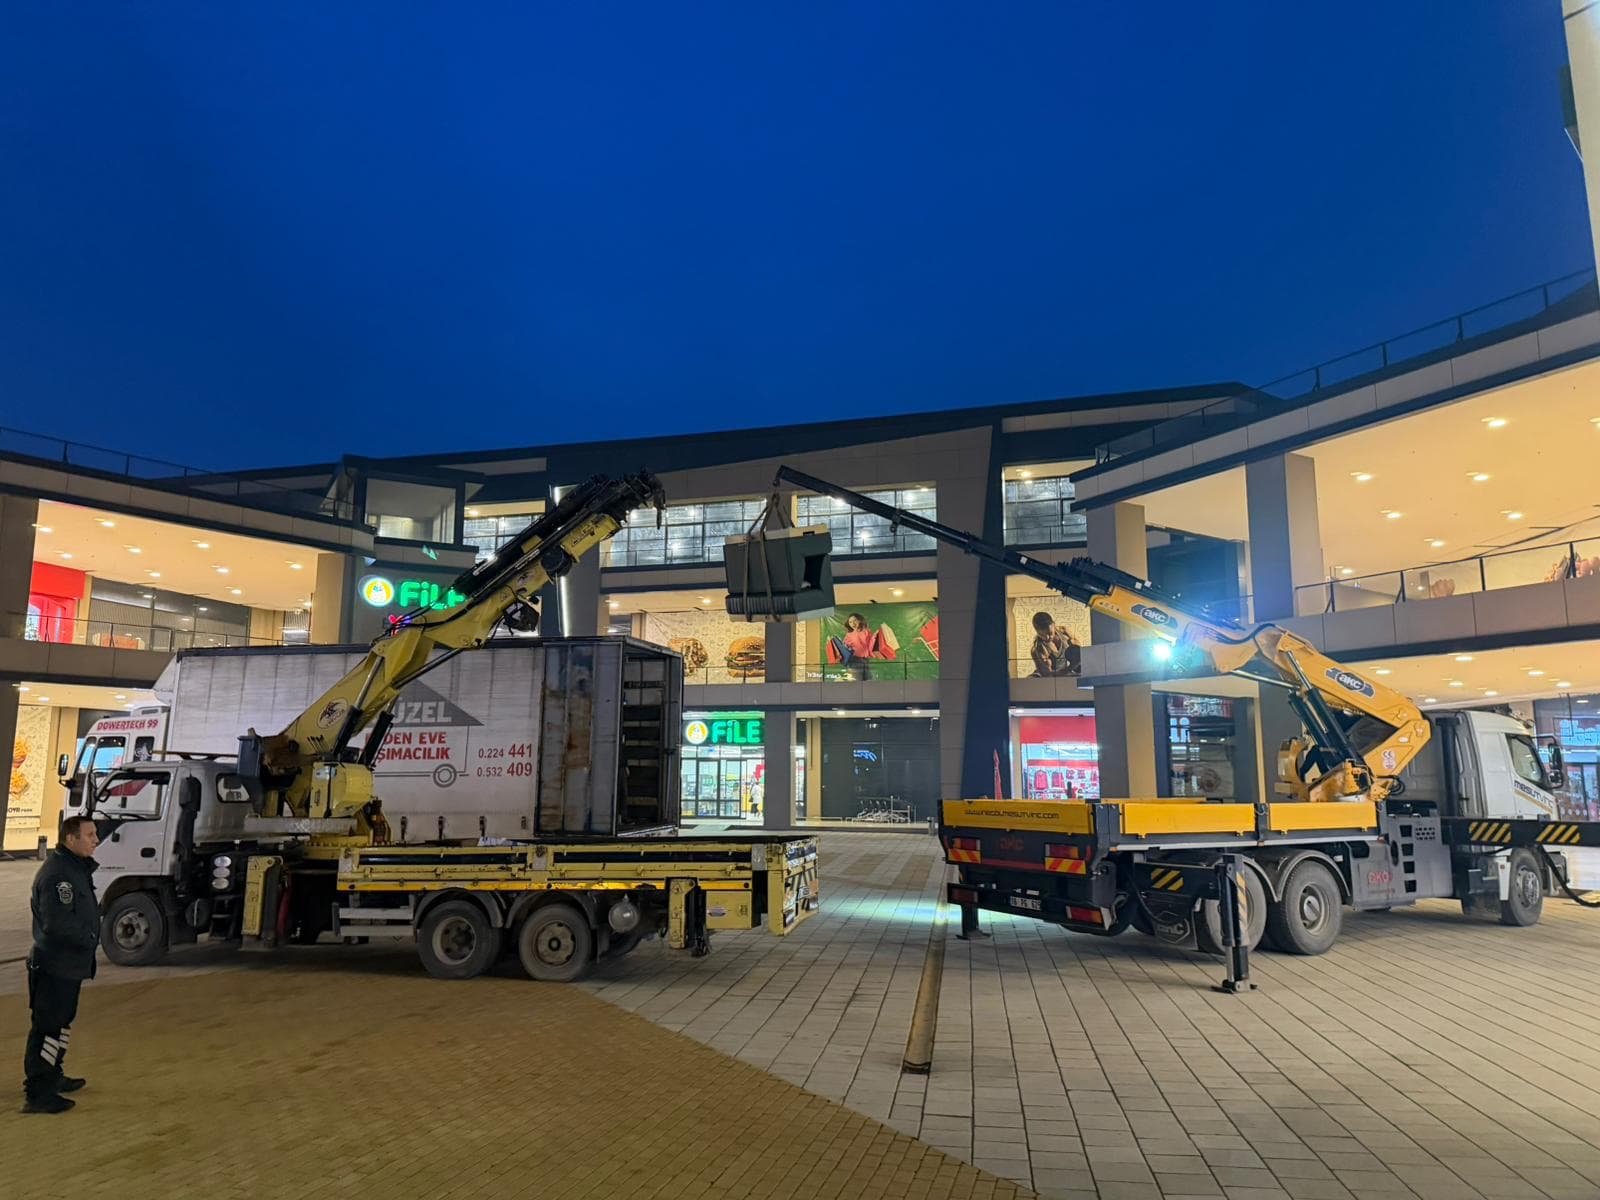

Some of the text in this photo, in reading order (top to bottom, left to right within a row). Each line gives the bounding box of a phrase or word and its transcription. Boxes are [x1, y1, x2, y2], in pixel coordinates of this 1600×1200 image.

[392, 698, 452, 723] ÜZEL
[147, 718, 159, 729] 99
[418, 731, 447, 744] EVE
[478, 743, 534, 760] 0.224 441
[476, 761, 534, 778] 0.532 409
